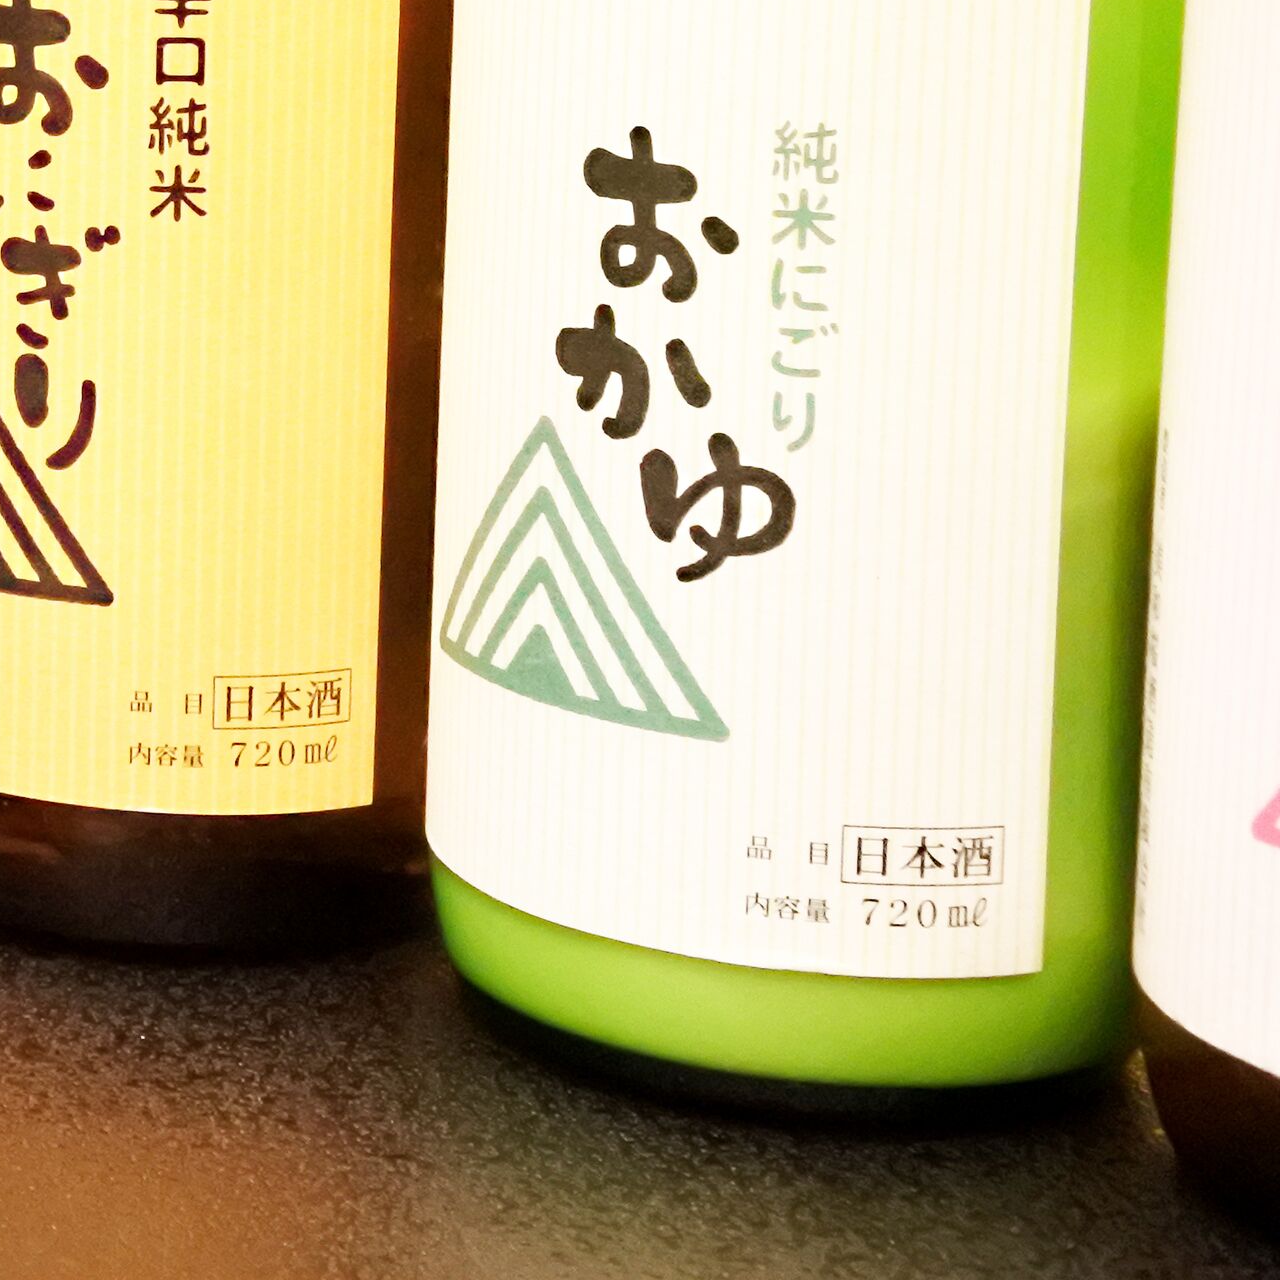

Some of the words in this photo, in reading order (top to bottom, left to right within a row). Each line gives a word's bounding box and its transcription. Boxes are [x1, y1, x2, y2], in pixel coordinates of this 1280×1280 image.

[771, 120, 840, 452] 純米にごり
[555, 125, 797, 583] おかゆ
[225, 676, 343, 723] 日本酒
[128, 741, 205, 769] 内容量
[855, 835, 994, 879] 日本酒
[745, 891, 831, 924] 内容量
